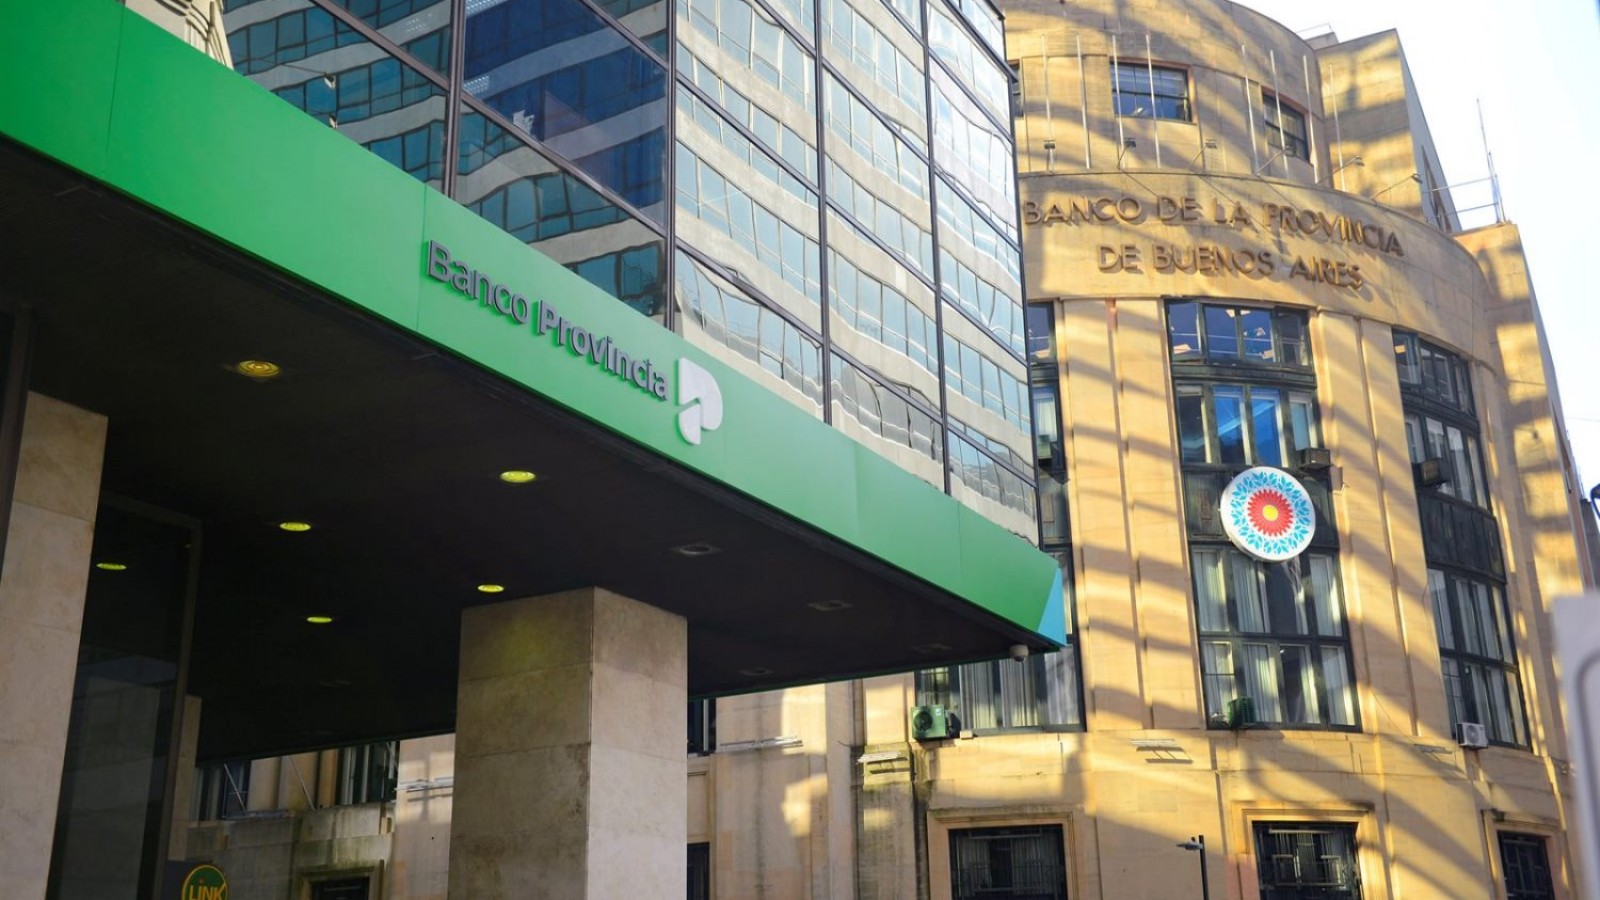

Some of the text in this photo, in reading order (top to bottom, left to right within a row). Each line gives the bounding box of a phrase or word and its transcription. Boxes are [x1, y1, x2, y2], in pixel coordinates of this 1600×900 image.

[1024, 196, 1404, 256] BANCO DE LA PROVINCIA
[1098, 244, 1363, 290] DE BUENOS AIRES
[428, 239, 668, 401] Banco Provincia
